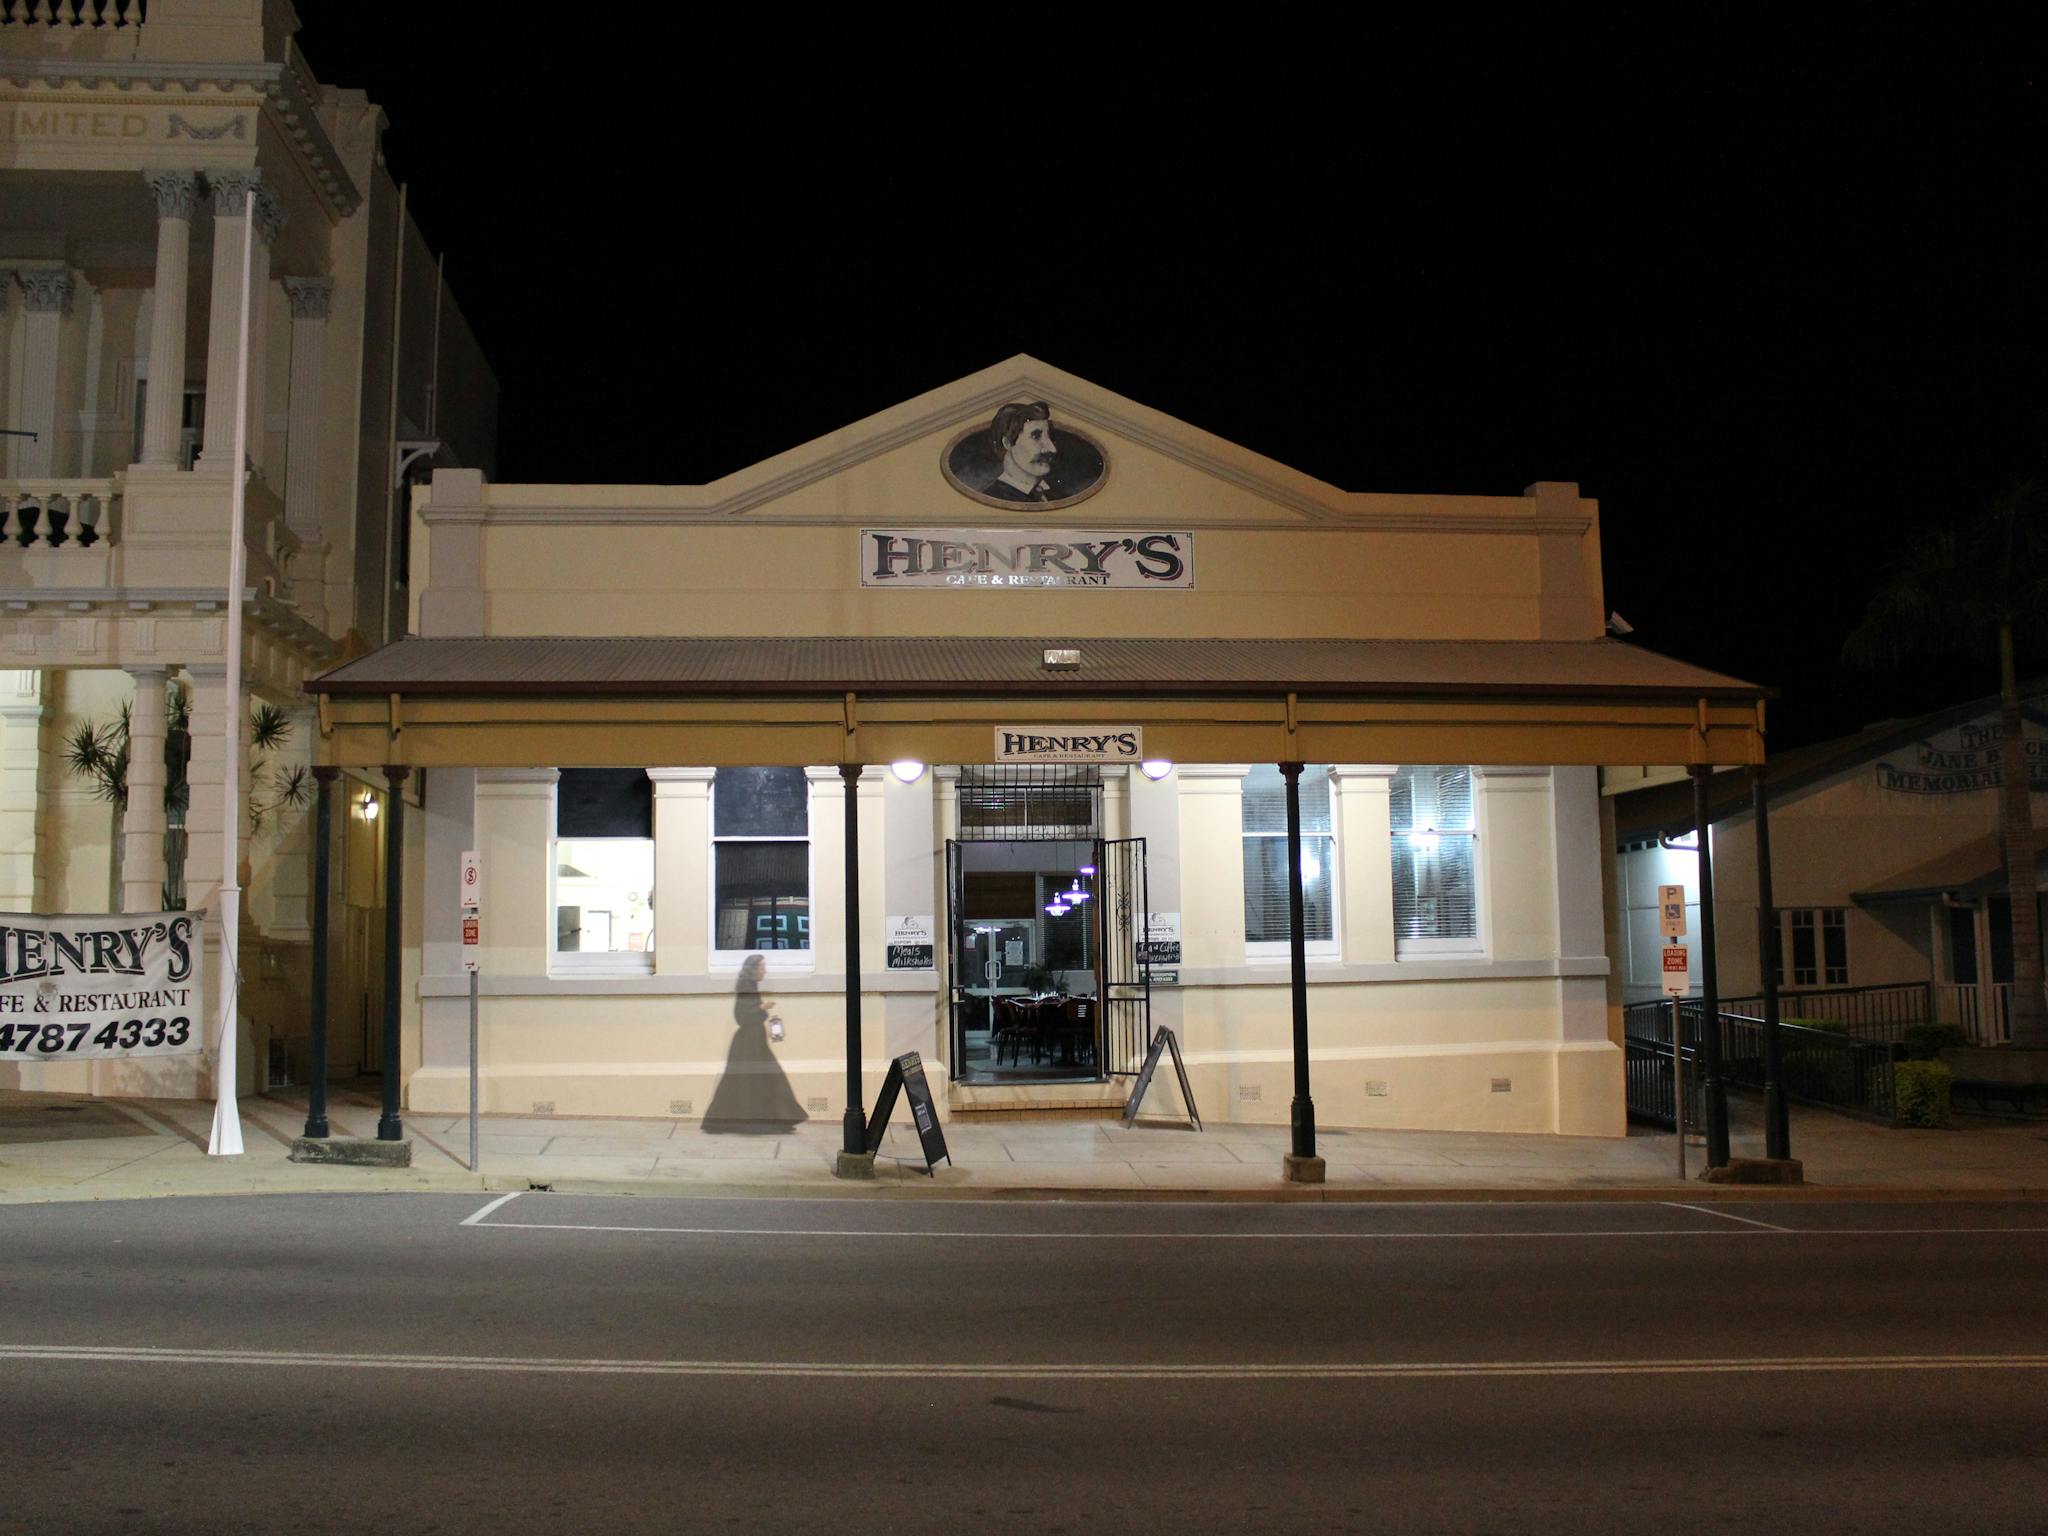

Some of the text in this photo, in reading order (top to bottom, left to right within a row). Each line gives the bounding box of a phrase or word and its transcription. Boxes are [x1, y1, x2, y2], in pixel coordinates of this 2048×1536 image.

[872, 534, 1184, 581] HENRY'S
[991, 575, 1004, 585] &
[1009, 575, 1107, 585] RESTARANT
[1003, 732, 1137, 755] HENRY'S
[1922, 750, 1978, 769] JANE
[1667, 888, 1676, 899] P
[34, 995, 49, 1013] &
[59, 989, 190, 1013] RESTAURANT
[0, 1017, 190, 1053] 4787 4333
